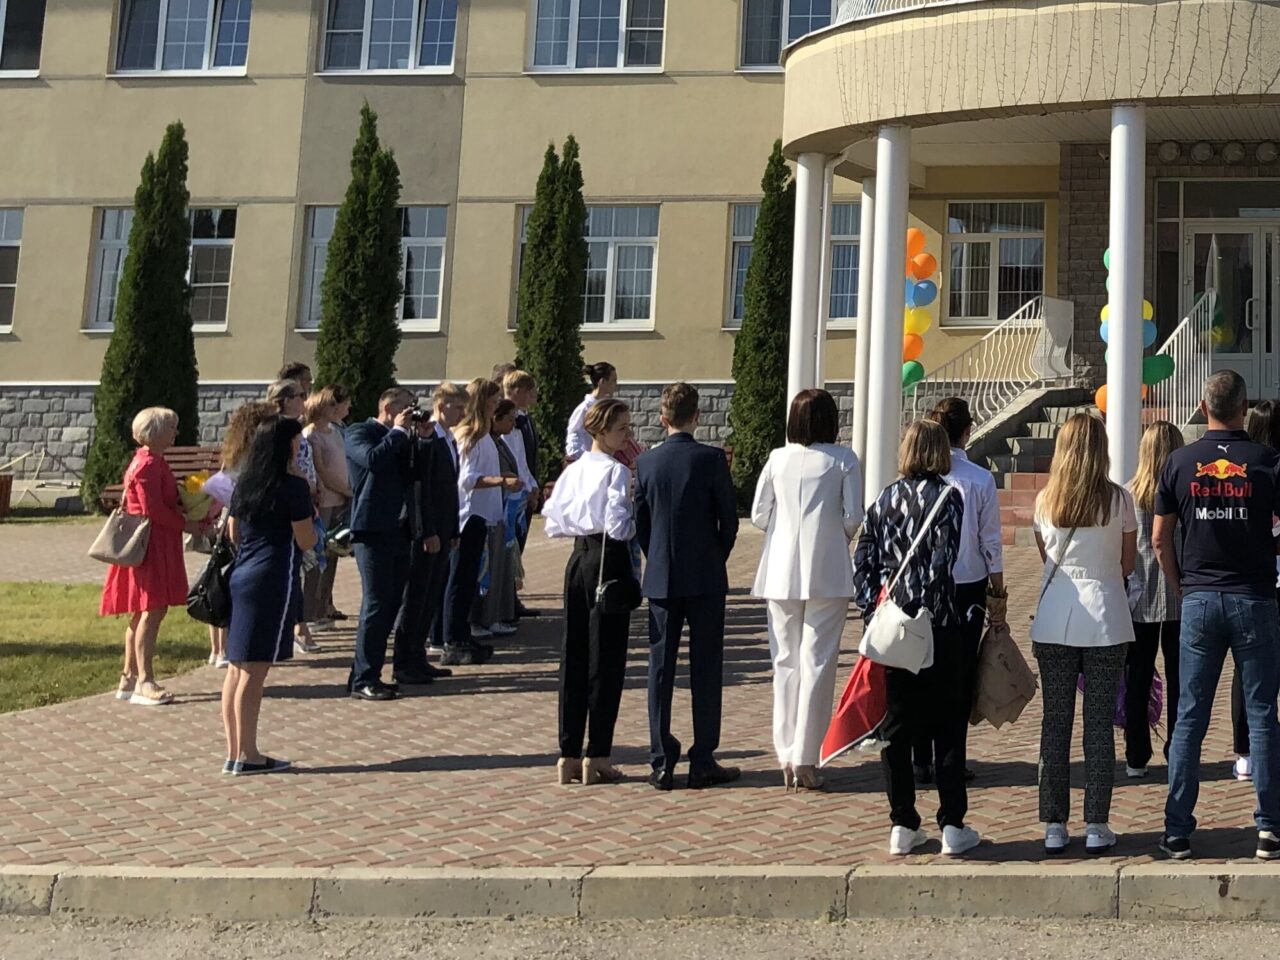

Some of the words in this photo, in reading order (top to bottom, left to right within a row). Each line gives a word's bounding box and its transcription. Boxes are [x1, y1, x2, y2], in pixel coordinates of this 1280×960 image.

[1190, 481, 1221, 497] Red
[1224, 481, 1252, 497] Bull
[1195, 507, 1232, 520] Mobil
